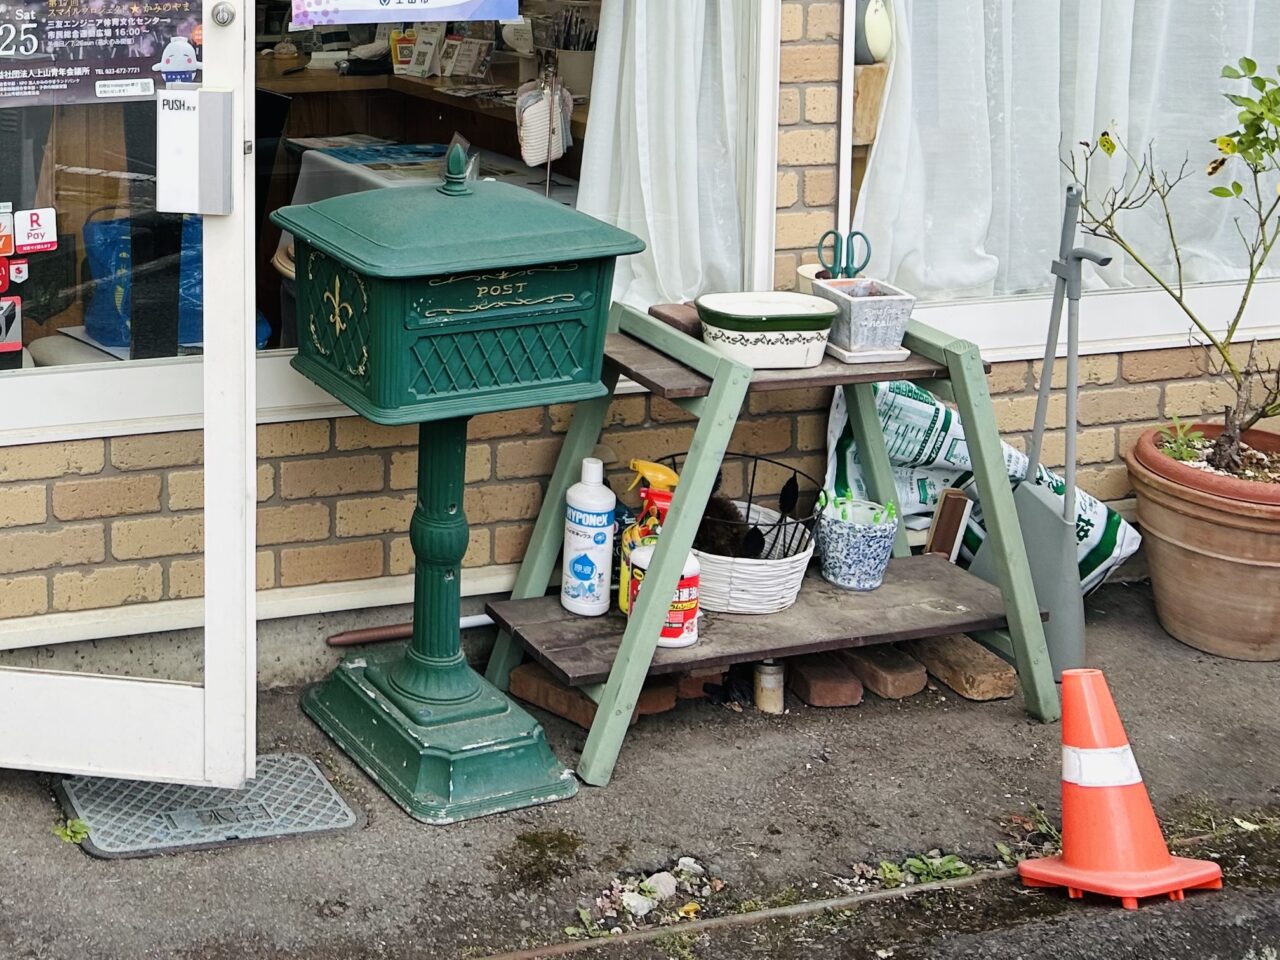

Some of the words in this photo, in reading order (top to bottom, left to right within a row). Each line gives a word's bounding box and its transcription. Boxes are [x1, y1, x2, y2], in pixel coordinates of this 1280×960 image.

[15, 9, 36, 21] Sat
[115, 28, 141, 37] 16:00
[162, 99, 186, 111] PUSH
[476, 282, 528, 297] POST
